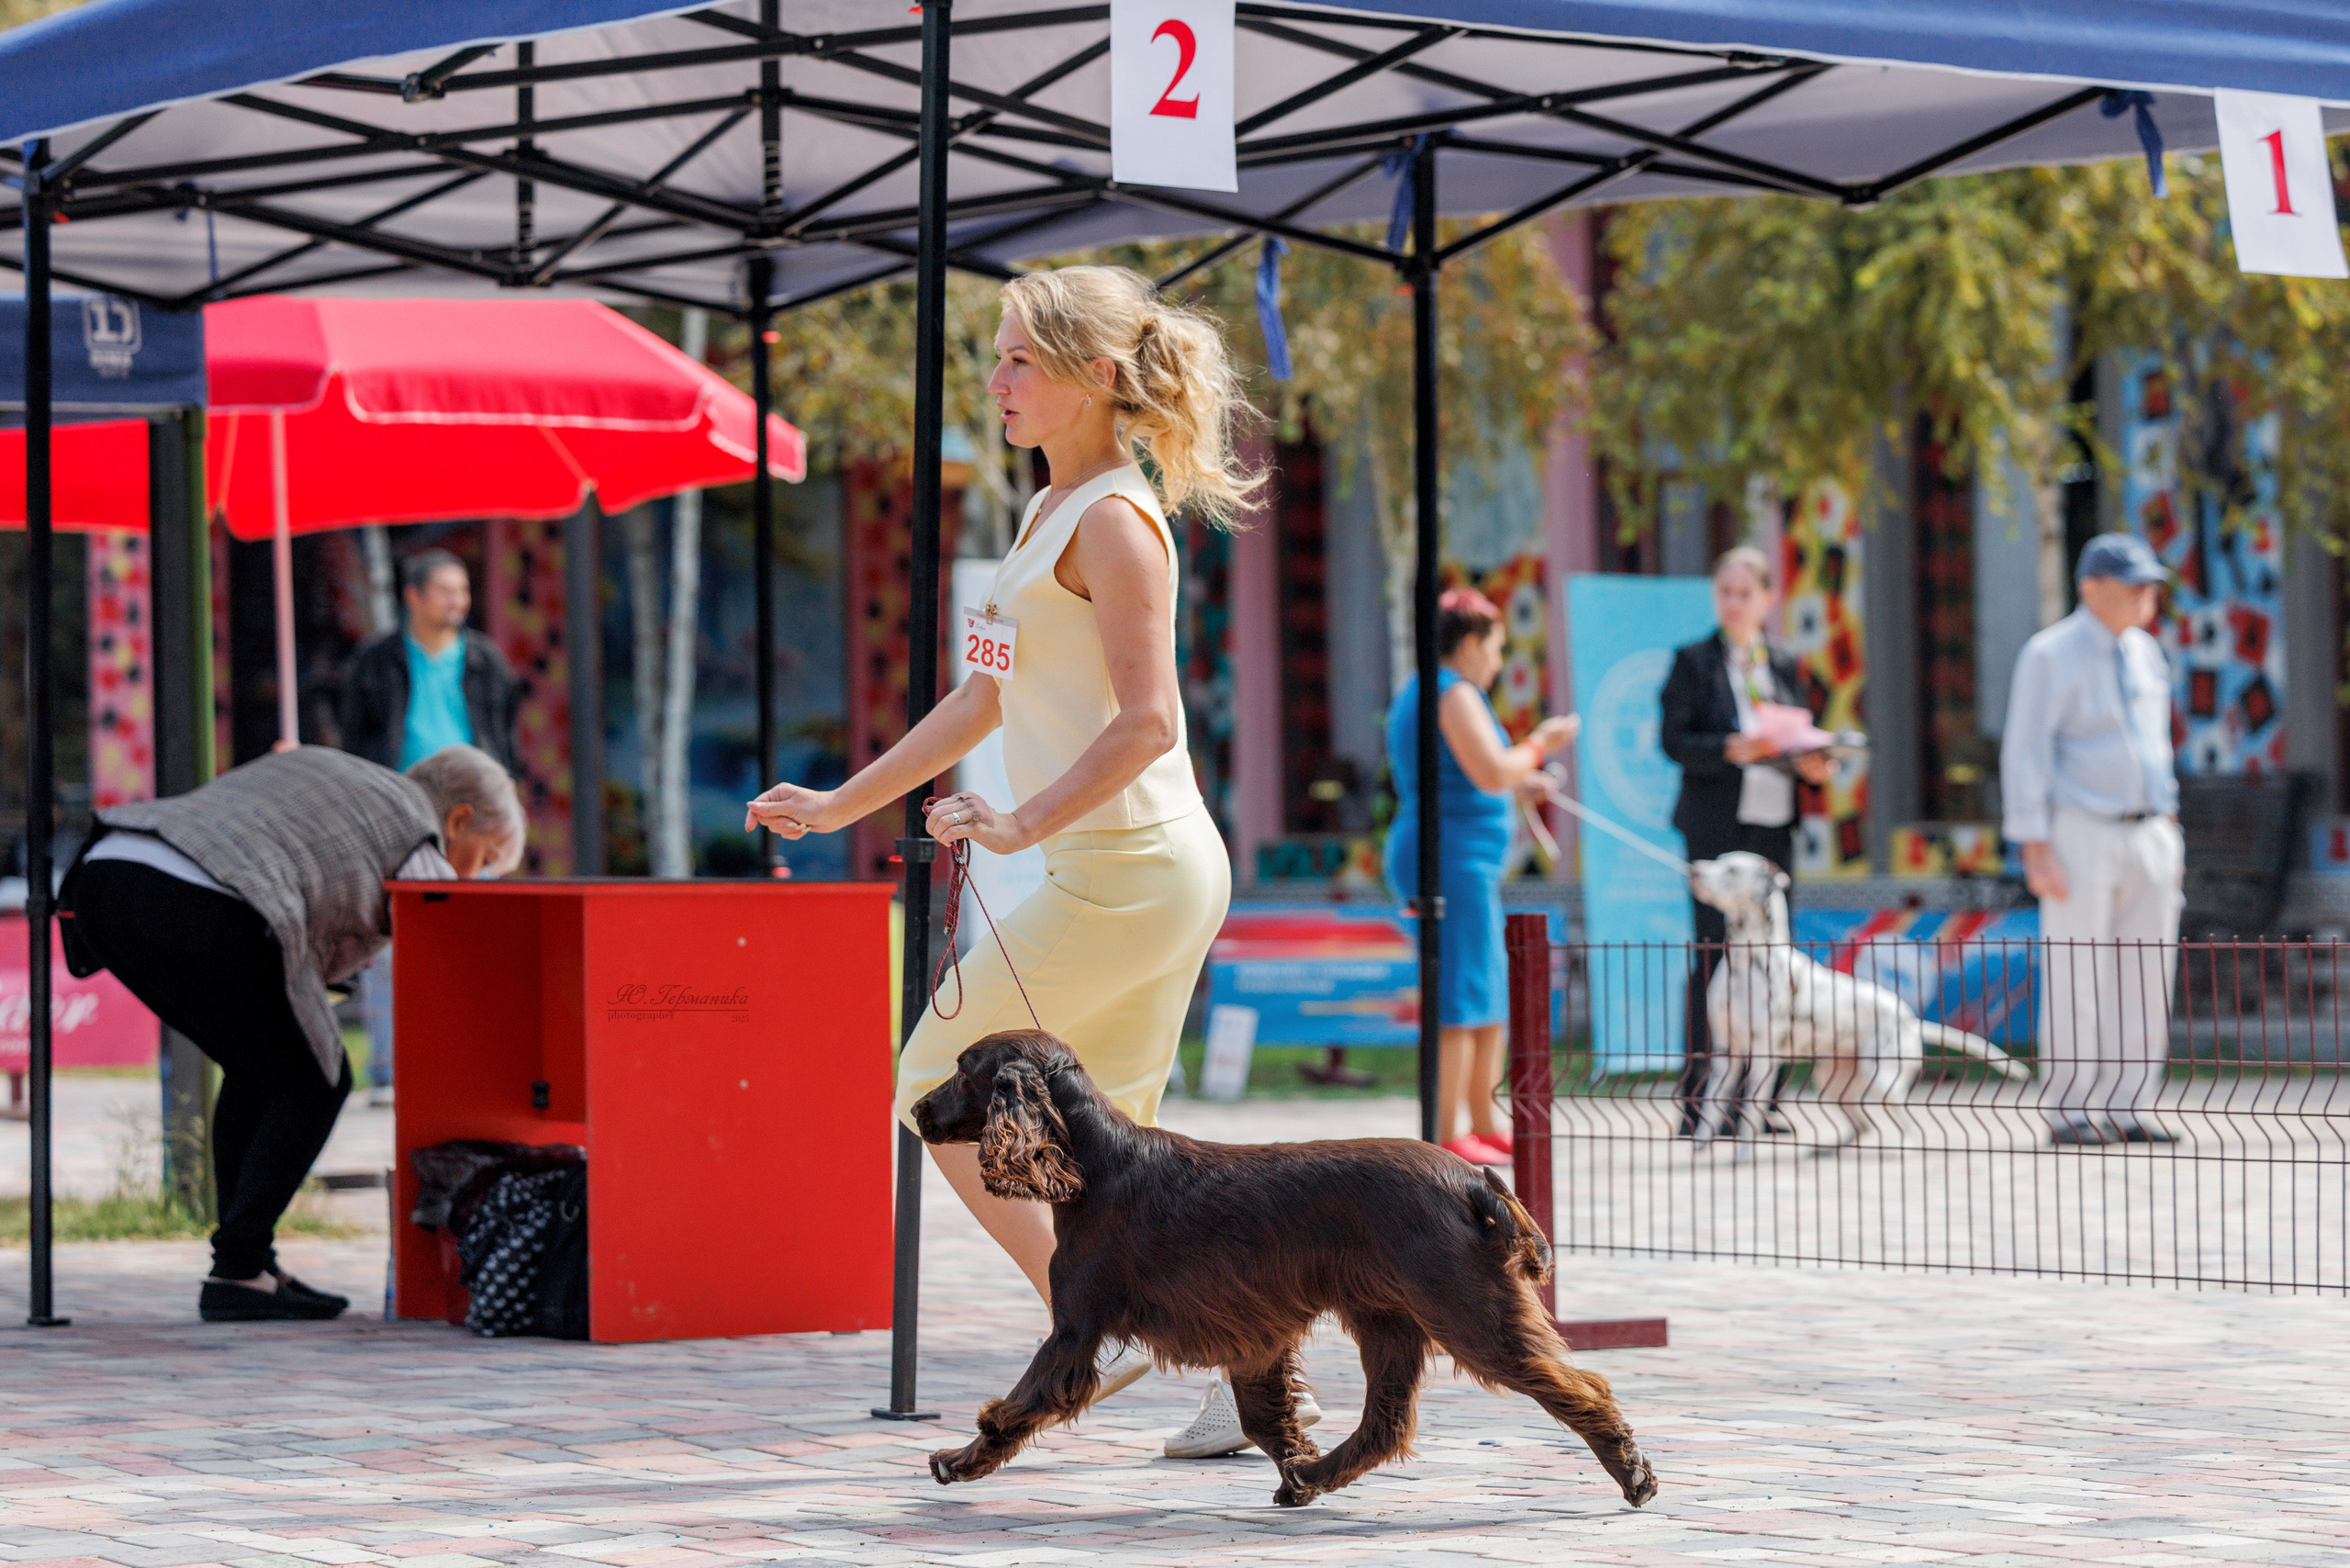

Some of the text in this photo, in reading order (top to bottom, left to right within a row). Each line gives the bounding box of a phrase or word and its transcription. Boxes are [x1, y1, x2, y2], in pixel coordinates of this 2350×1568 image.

[1149, 18, 1200, 119] 2
[2257, 129, 2302, 217] 1
[967, 634, 1010, 671] 285
